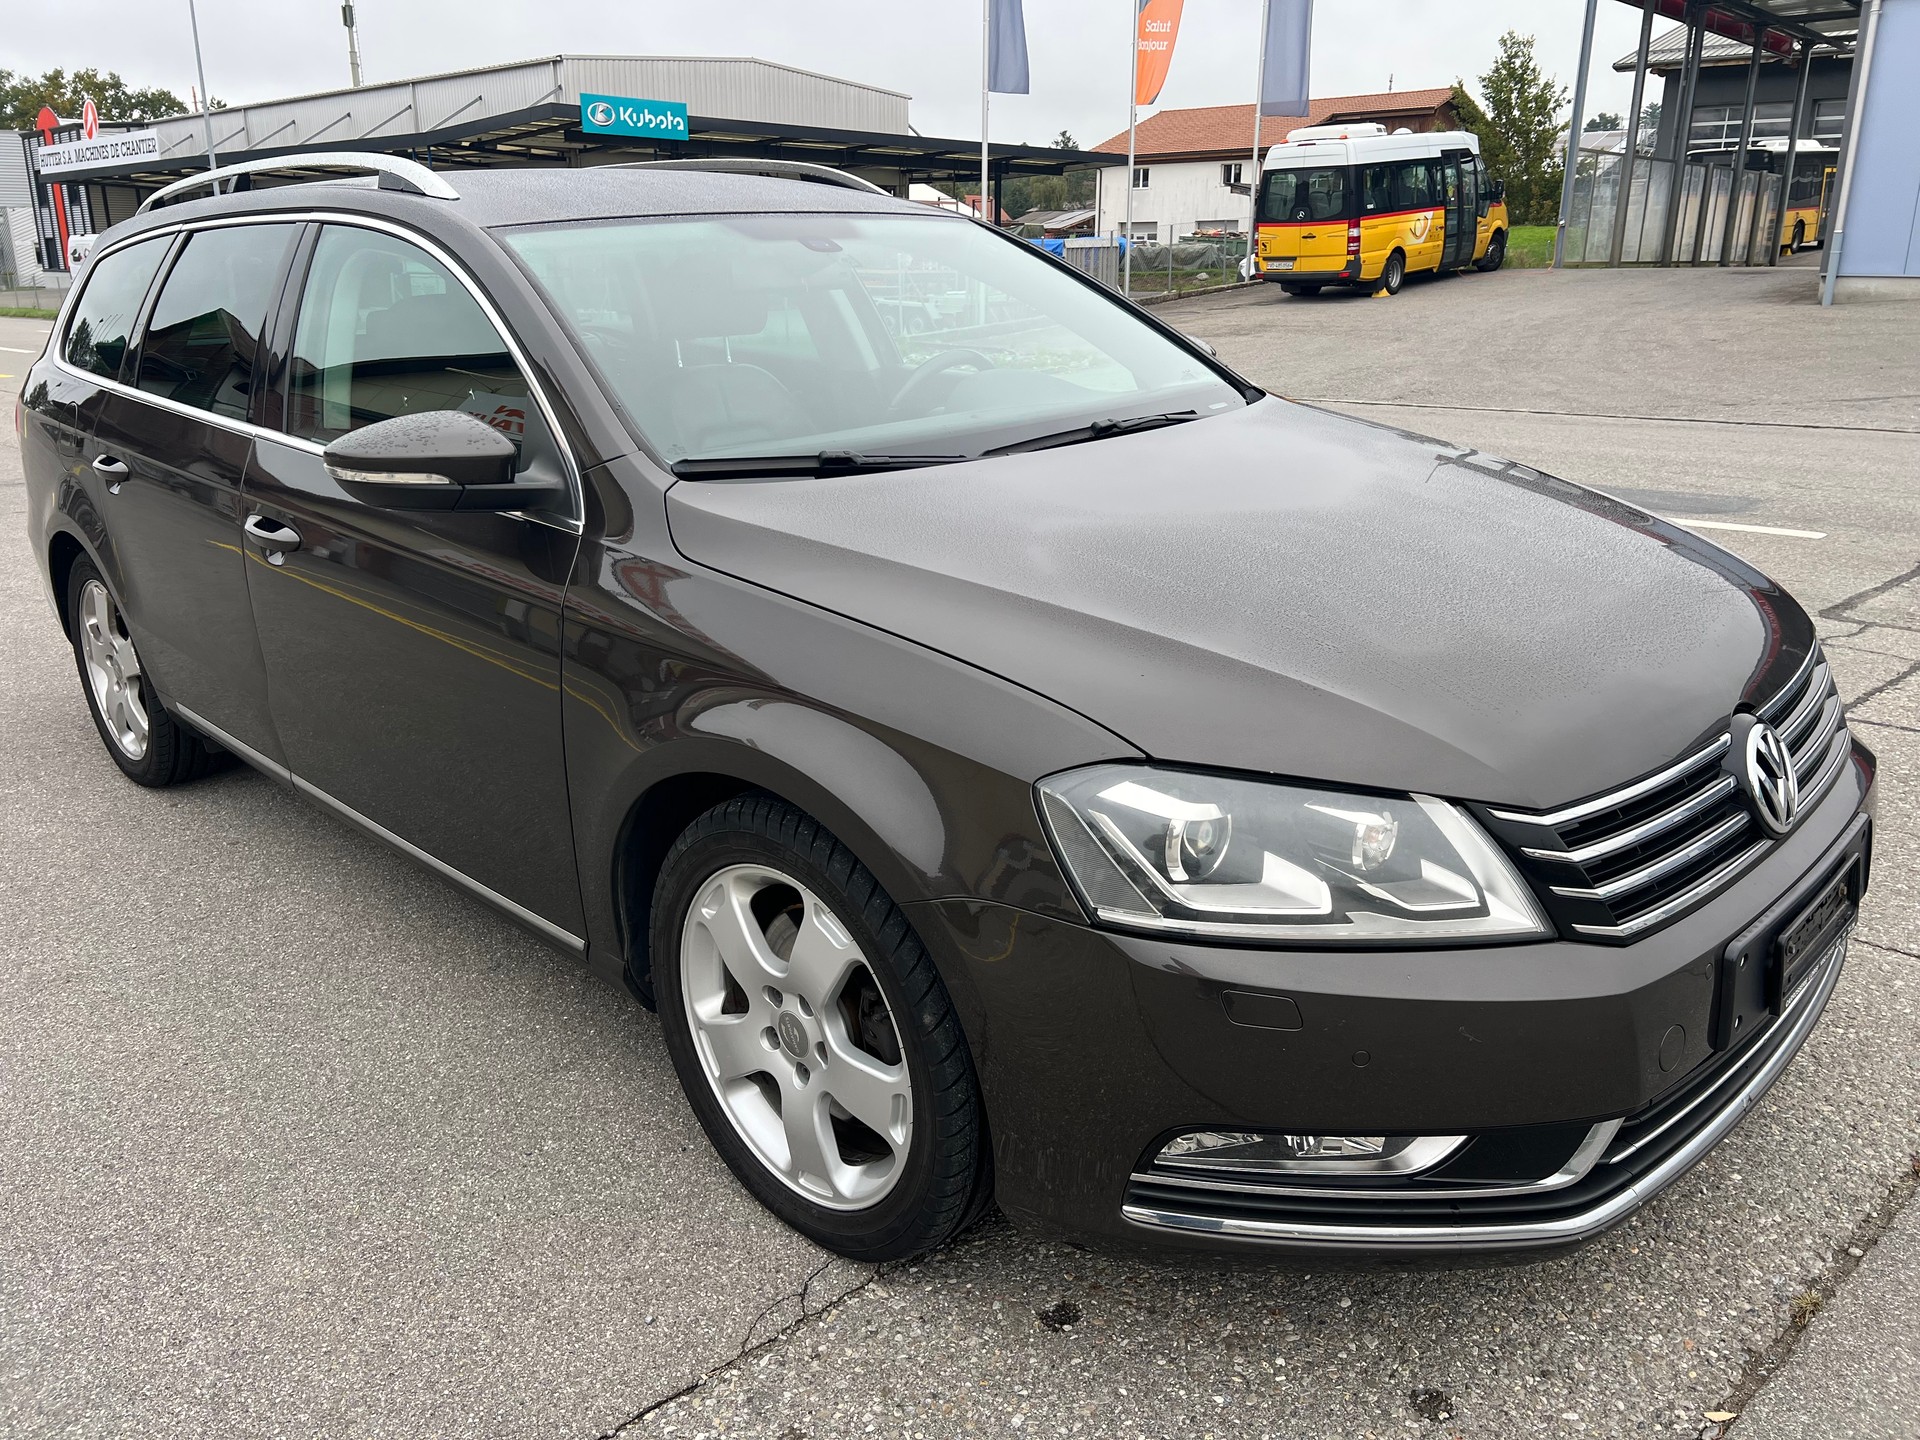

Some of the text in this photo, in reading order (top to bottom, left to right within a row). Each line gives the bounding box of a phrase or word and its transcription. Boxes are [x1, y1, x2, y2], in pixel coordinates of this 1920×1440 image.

[1145, 19, 1171, 32] Salut
[619, 106, 684, 131] Kubota
[40, 151, 62, 168] HUTTER
[74, 144, 109, 163] MACHINES
[110, 143, 120, 158] DE
[120, 137, 157, 157] CHANTIER
